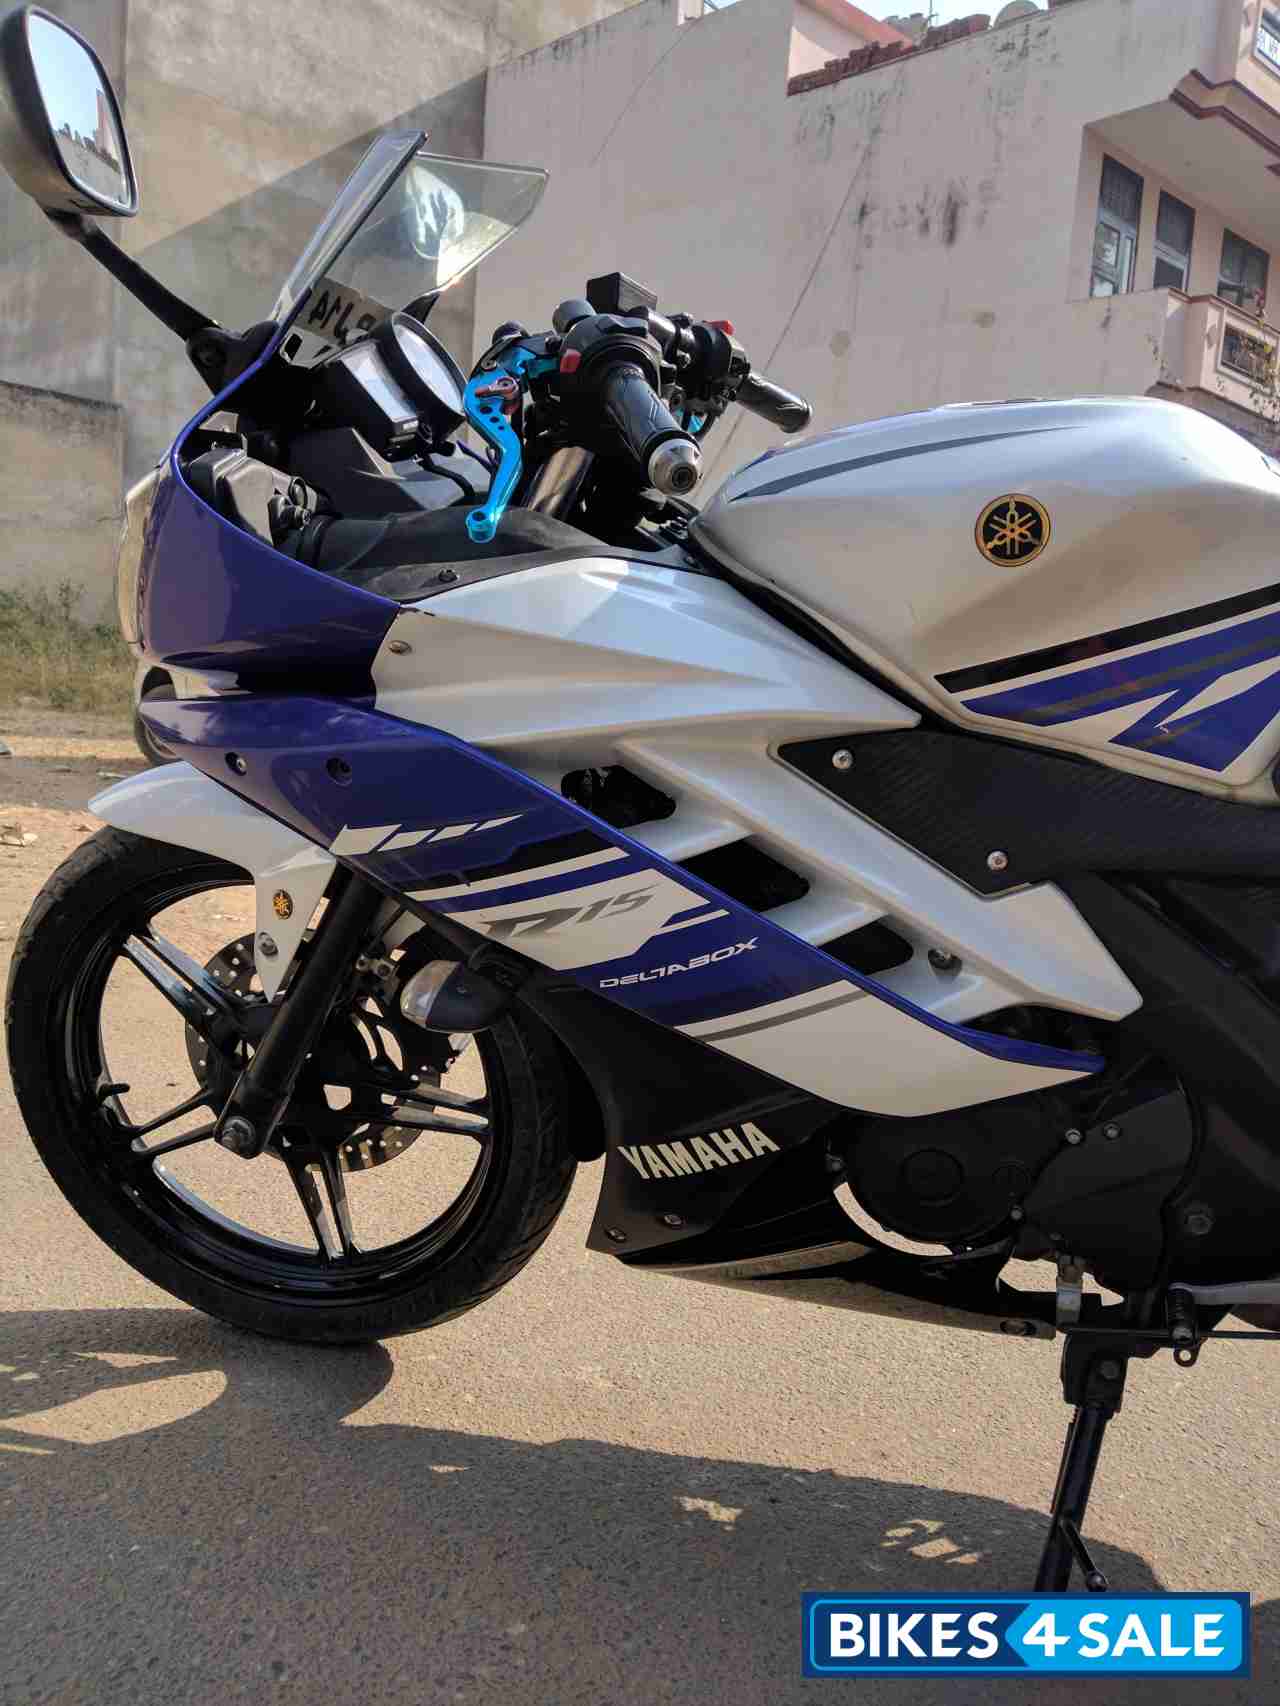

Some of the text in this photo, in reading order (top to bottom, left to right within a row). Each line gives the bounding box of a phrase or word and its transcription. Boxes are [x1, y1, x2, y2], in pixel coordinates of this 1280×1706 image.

[479, 883, 660, 938] R15
[599, 937, 759, 988] DELTABOX
[617, 1121, 780, 1180] YAMAHA
